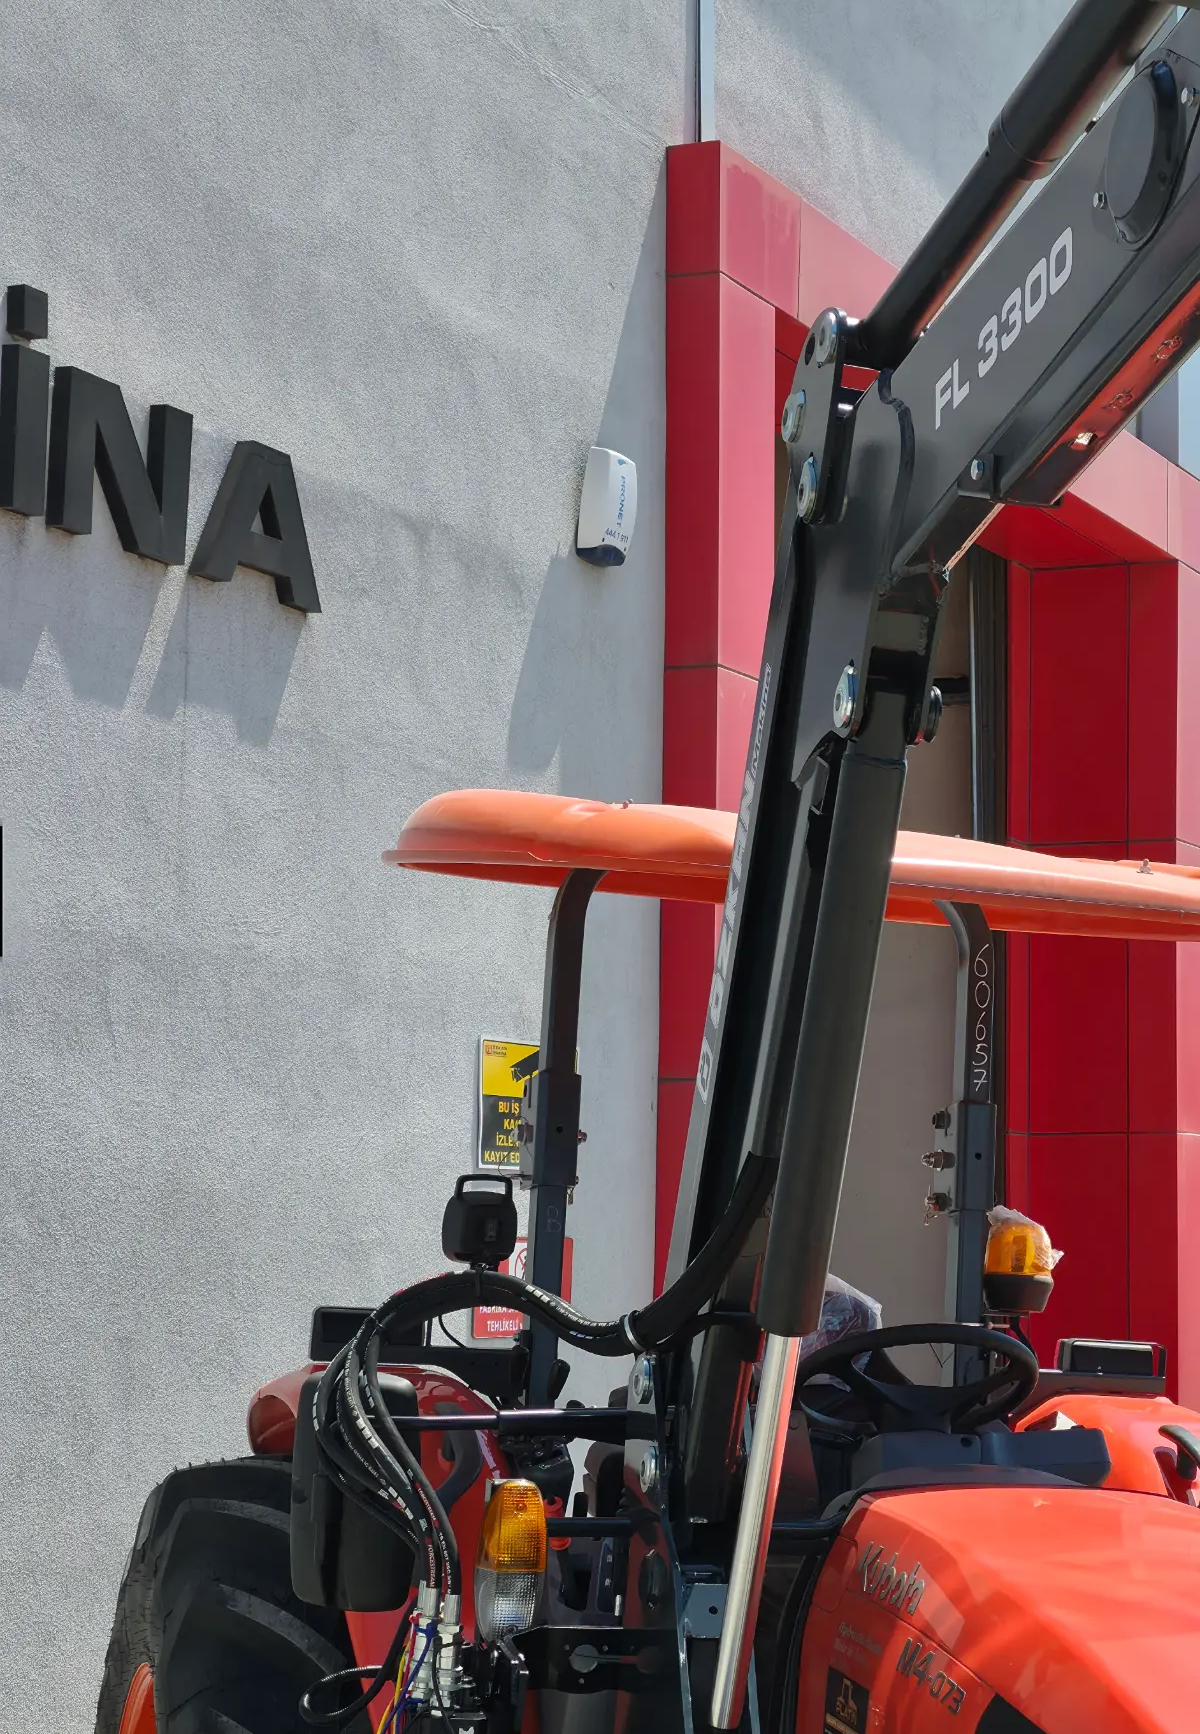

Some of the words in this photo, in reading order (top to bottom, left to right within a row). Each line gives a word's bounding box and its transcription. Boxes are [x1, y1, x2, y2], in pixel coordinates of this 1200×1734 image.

[936, 358, 969, 431] FL
[978, 227, 1073, 379] 3300
[616, 475, 626, 528] PRONET
[498, 1101, 509, 1113] BU
[484, 1150, 508, 1163] KAYIT
[427, 1544, 436, 1588] FORCESTREAM
[858, 1541, 925, 1616] Kubota
[896, 1636, 967, 1716] M4-073
